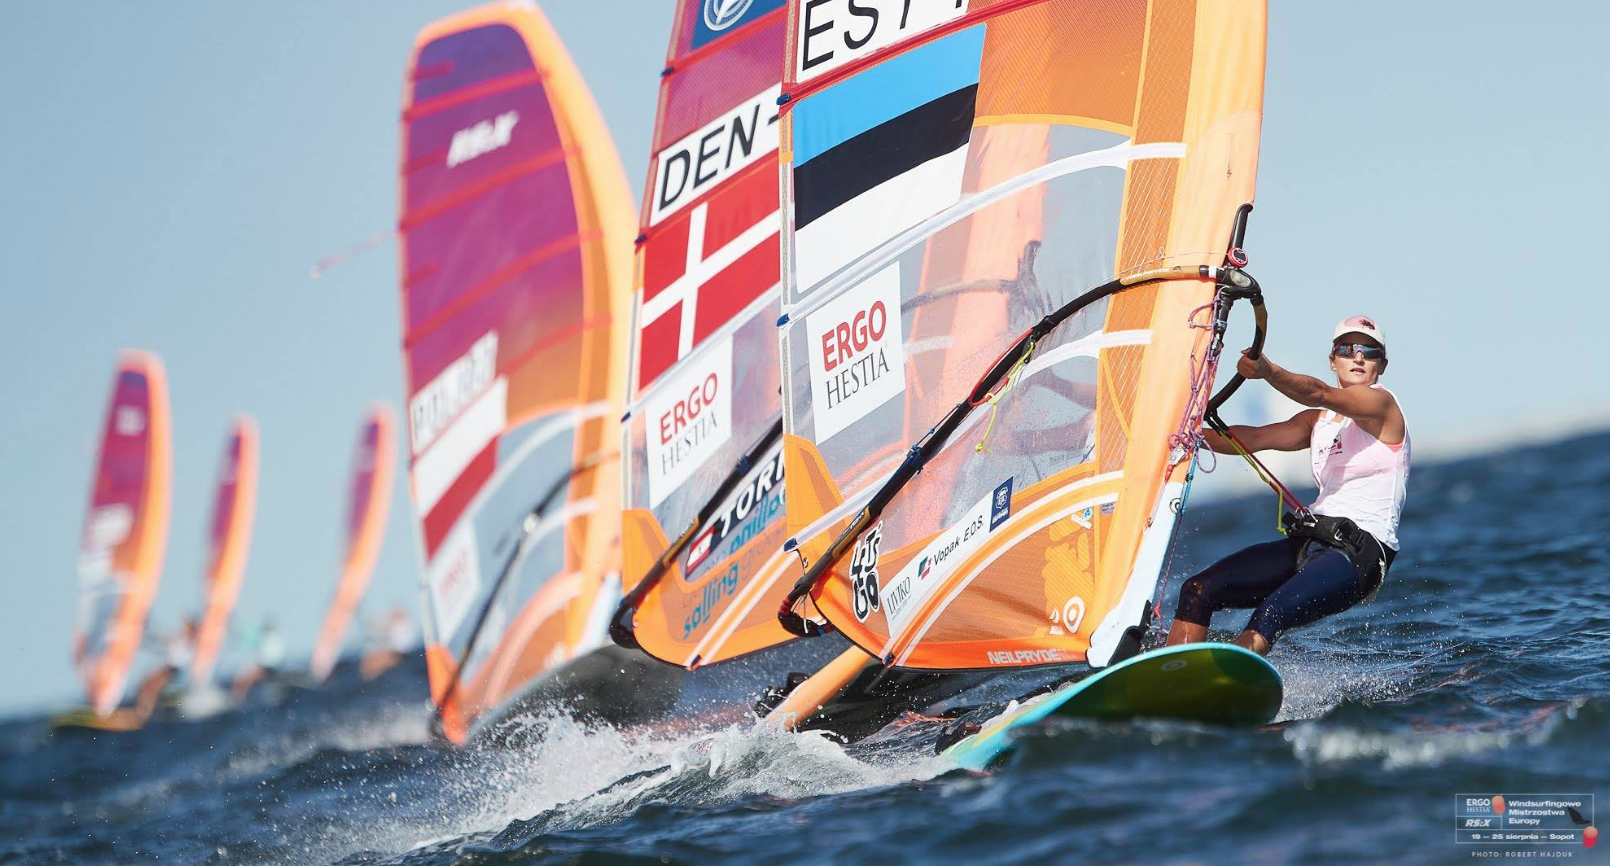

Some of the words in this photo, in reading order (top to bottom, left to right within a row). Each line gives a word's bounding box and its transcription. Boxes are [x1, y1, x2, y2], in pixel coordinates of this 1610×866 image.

[822, 300, 887, 372] ERGO
[660, 372, 718, 446] ERGO
[826, 347, 890, 410] HESTIA
[662, 410, 717, 475] HESTIA
[933, 536, 961, 566] Vopak
[963, 514, 984, 542] E.O.S.
[986, 648, 1061, 665] NEILPRYDE
